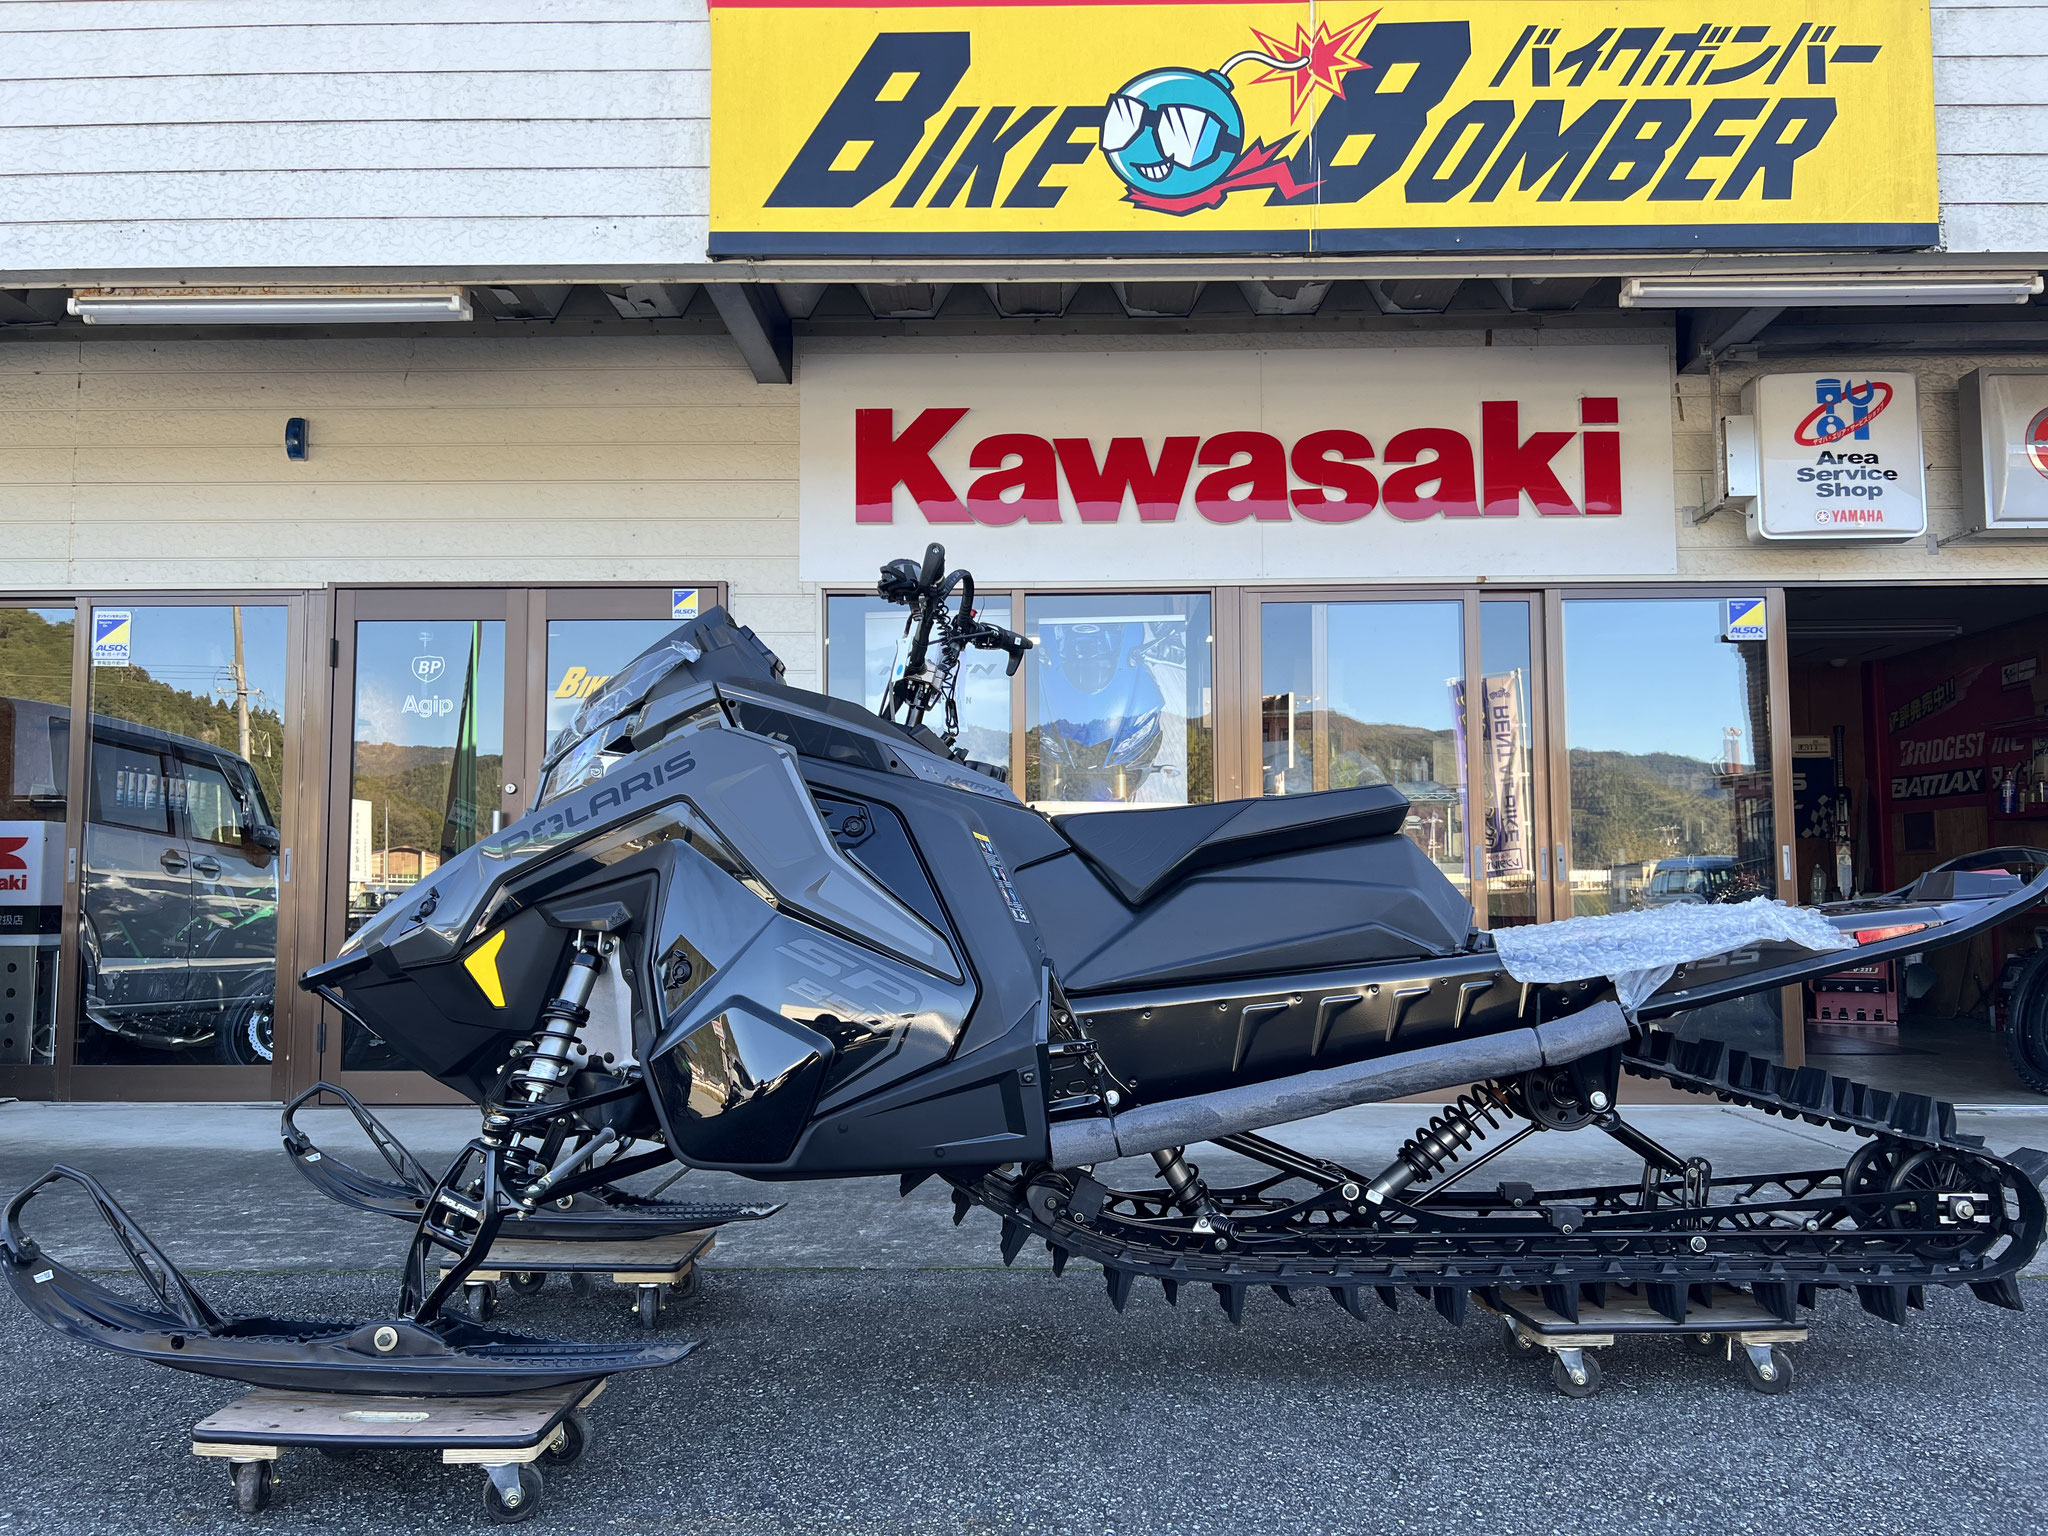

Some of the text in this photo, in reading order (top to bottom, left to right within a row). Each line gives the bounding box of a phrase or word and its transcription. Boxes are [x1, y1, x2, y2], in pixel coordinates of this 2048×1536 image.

[1489, 22, 1882, 88] バイクボンバー
[763, 20, 1837, 208] BIKE BOMBER
[855, 396, 1623, 526] Kawasaki
[1816, 450, 1879, 466] Area
[1796, 465, 1898, 482] Service
[1816, 483, 1883, 500] Shop
[1832, 510, 1884, 523] YAMAHA
[1730, 626, 1764, 634] ALSOK
[96, 644, 128, 652] ALSOK
[418, 660, 442, 675] BP
[554, 666, 612, 699] BIK
[401, 695, 454, 718] Agip
[943, 774, 1005, 798] MATRYX
[1892, 768, 1984, 799] BATTLAX
[500, 749, 697, 862] POLARIS
[440, 1194, 479, 1219] POLARIS
